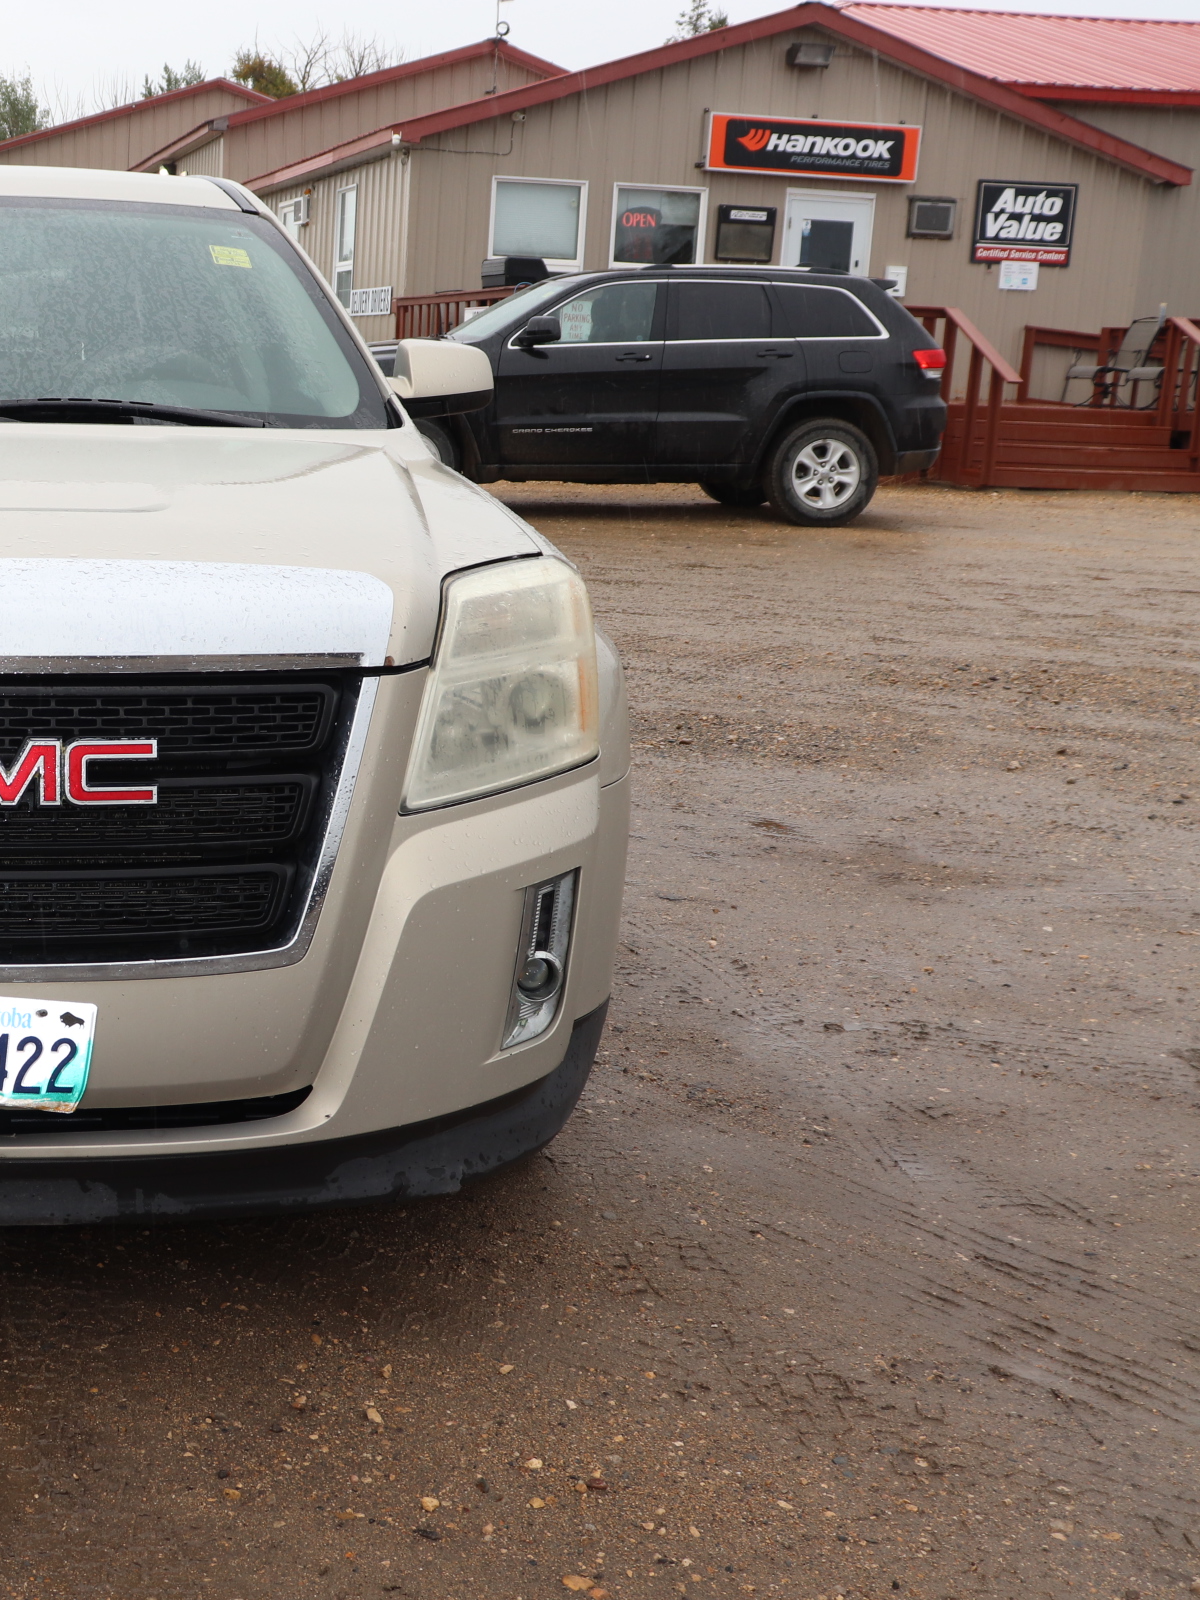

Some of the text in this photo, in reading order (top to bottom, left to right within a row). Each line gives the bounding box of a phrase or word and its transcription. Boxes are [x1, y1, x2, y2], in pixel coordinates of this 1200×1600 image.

[790, 155, 891, 169] PERFORMANCE TIRES
[990, 187, 1064, 216] Auto
[622, 212, 656, 227] OPEN
[985, 212, 1064, 242] Value
[977, 248, 1066, 261] Certified Service Centers
[571, 303, 584, 312] NO
[563, 313, 591, 323] PARKING
